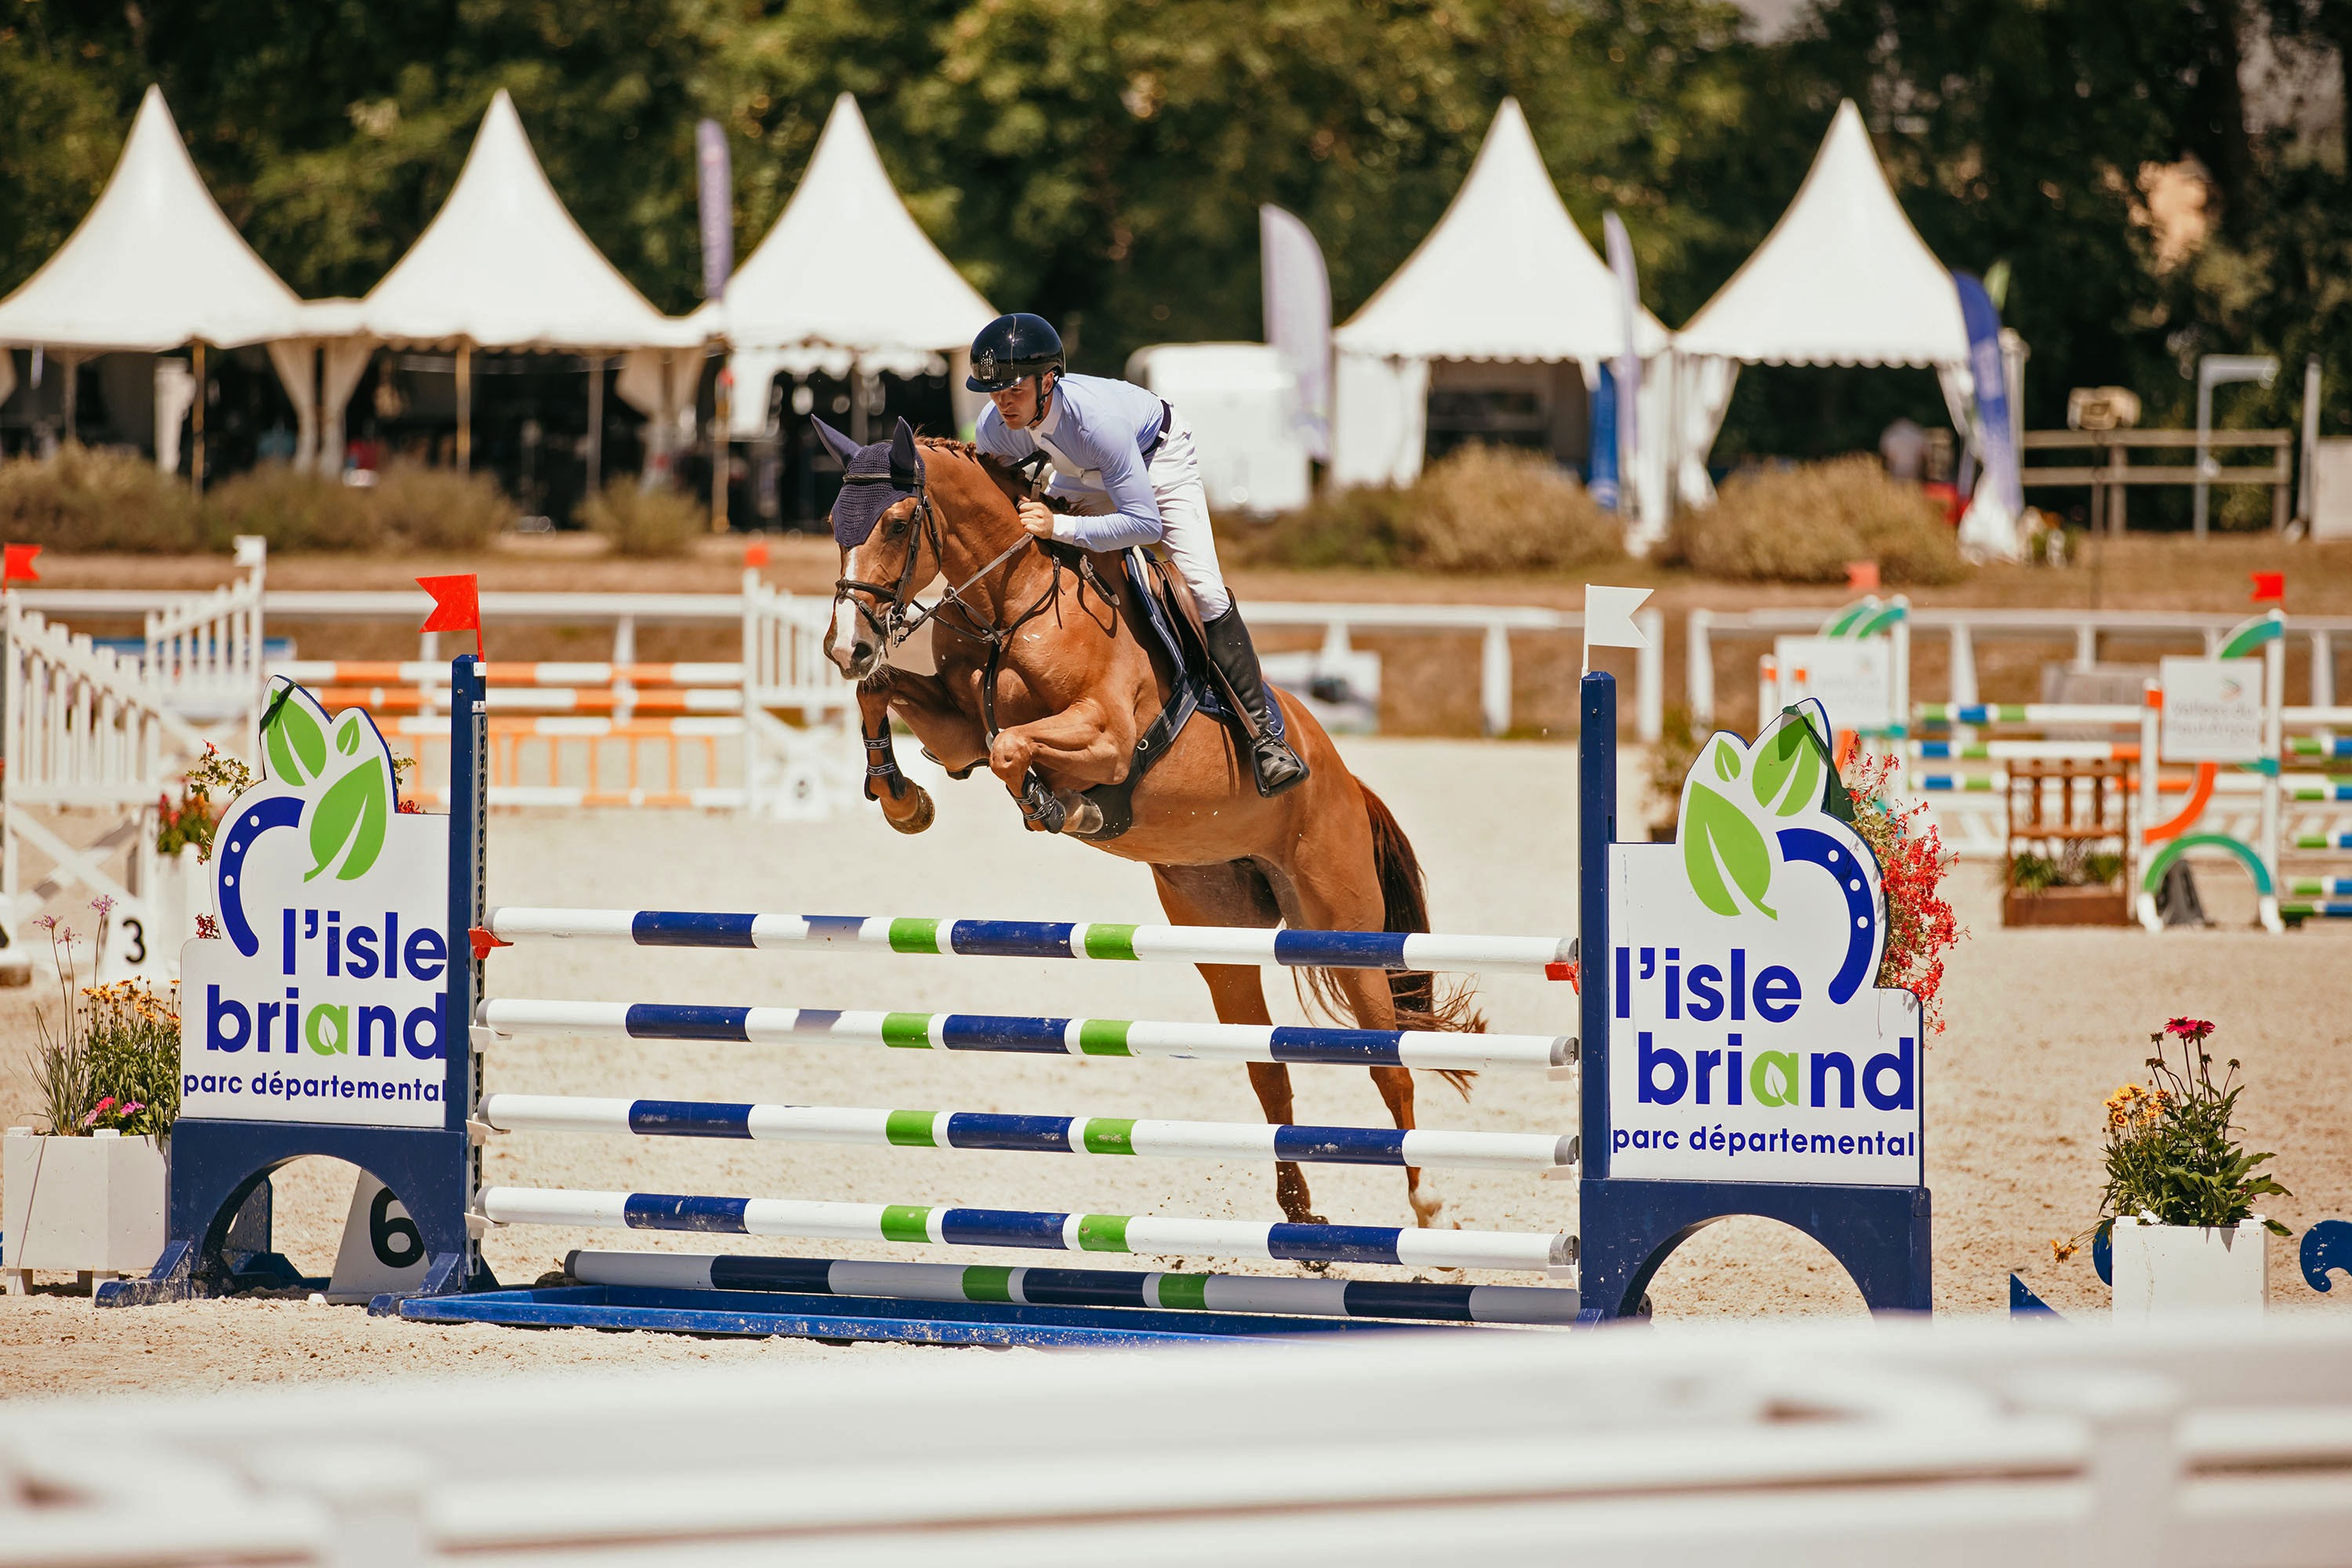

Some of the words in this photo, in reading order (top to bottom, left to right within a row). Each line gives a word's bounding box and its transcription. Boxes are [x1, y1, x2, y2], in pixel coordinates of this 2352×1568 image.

[122, 919, 146, 964] 3
[283, 908, 447, 981] l’isle
[1616, 947, 1802, 1022] l’isle
[207, 984, 447, 1060] briand
[183, 1074, 242, 1096] parc
[252, 1070, 447, 1102] départemental
[1639, 1032, 1914, 1111] briand
[1613, 1129, 1679, 1153] parc
[1689, 1123, 1914, 1156] départemental
[370, 1186, 426, 1268] 6
